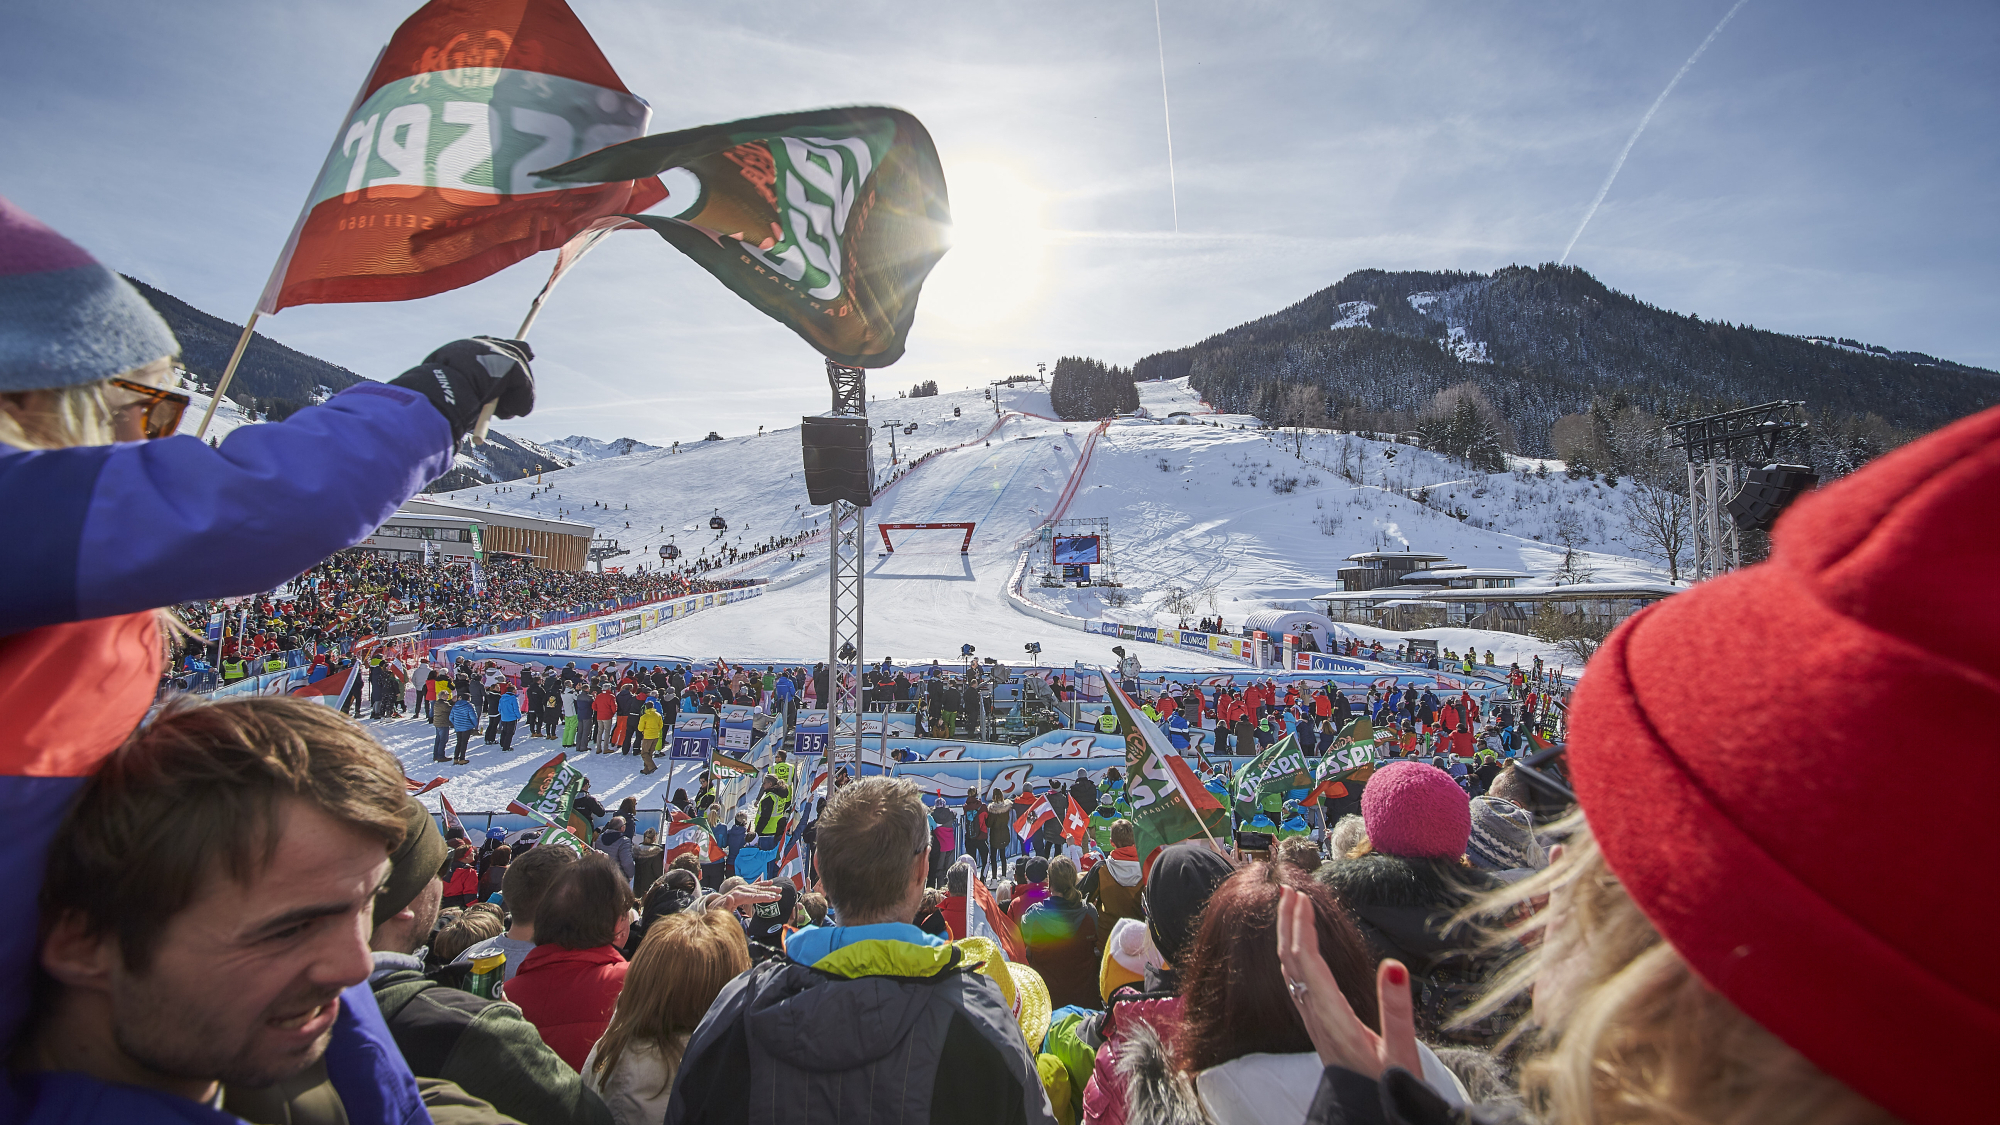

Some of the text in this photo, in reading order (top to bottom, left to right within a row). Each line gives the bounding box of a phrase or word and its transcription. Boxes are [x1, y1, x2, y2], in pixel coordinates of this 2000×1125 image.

[1142, 630, 1156, 640] UNIQA
[1188, 635, 1207, 647] UNIQA
[545, 636, 568, 650] UNIQA
[683, 741, 700, 755] 12
[803, 735, 821, 750] 35
